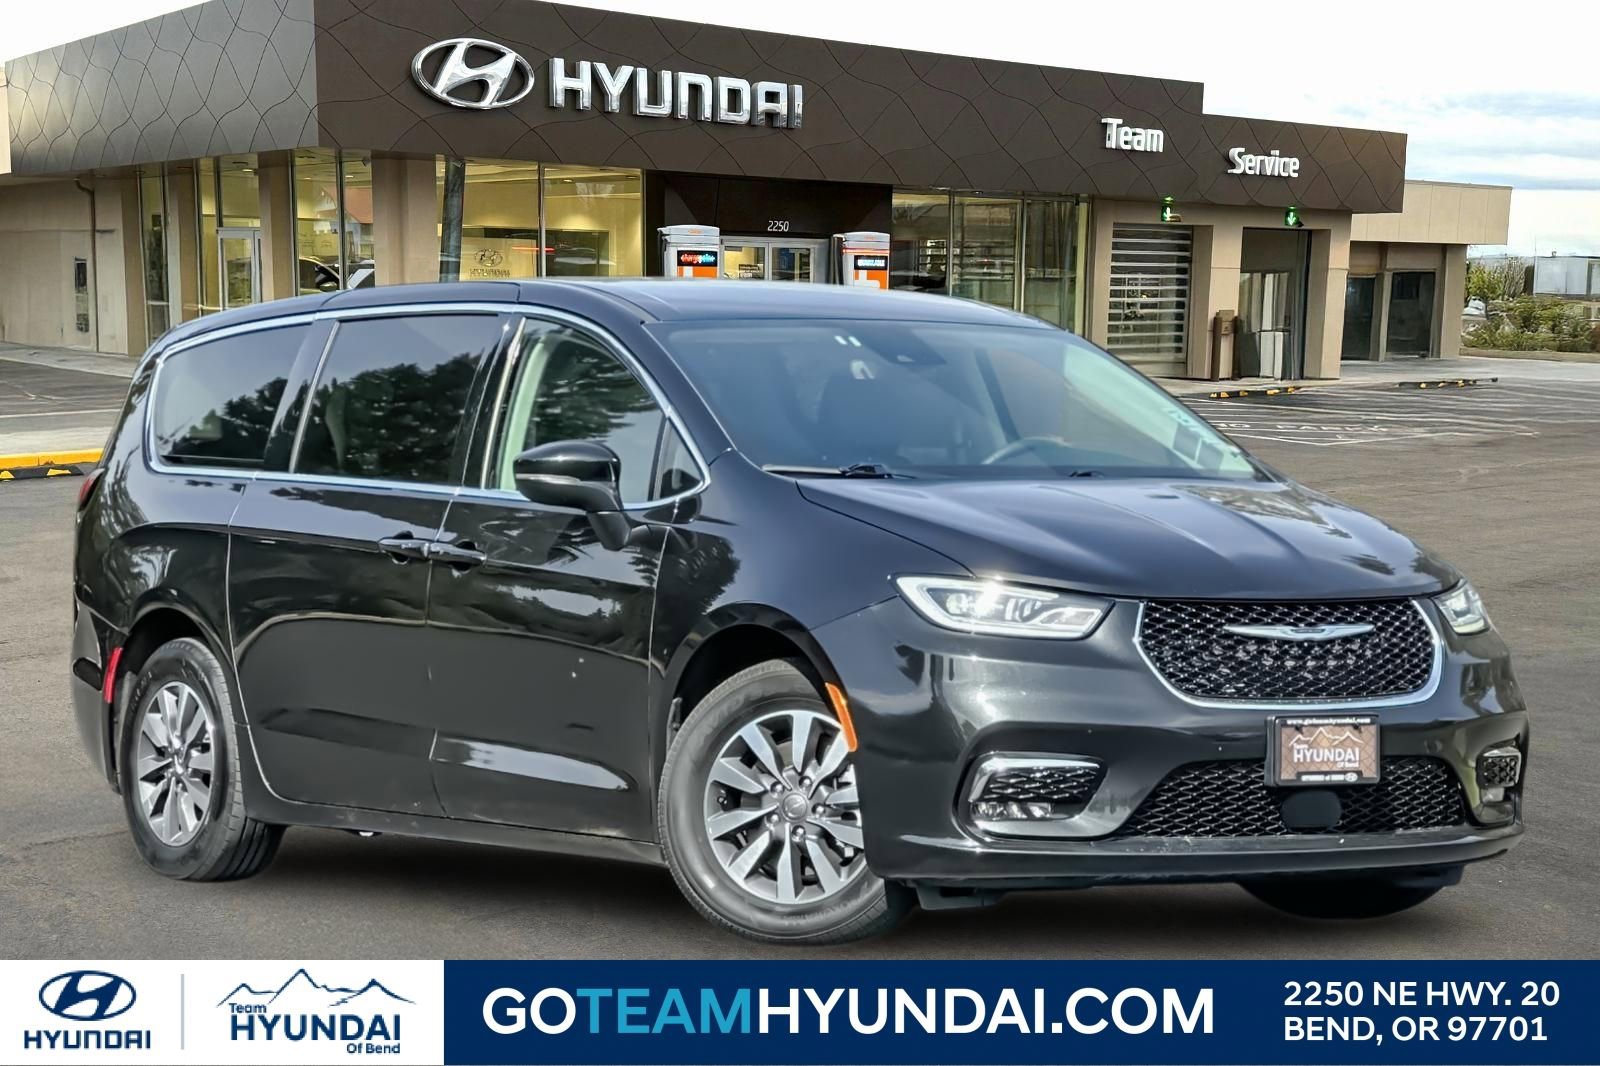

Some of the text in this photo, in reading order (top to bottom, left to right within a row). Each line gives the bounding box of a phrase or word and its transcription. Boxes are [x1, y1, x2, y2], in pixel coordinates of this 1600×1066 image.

[548, 57, 803, 129] HYUNDAI
[1101, 117, 1164, 153] Team
[1227, 147, 1300, 178] Service
[767, 220, 790, 232] 2250
[1293, 747, 1360, 763] HYUNDAI
